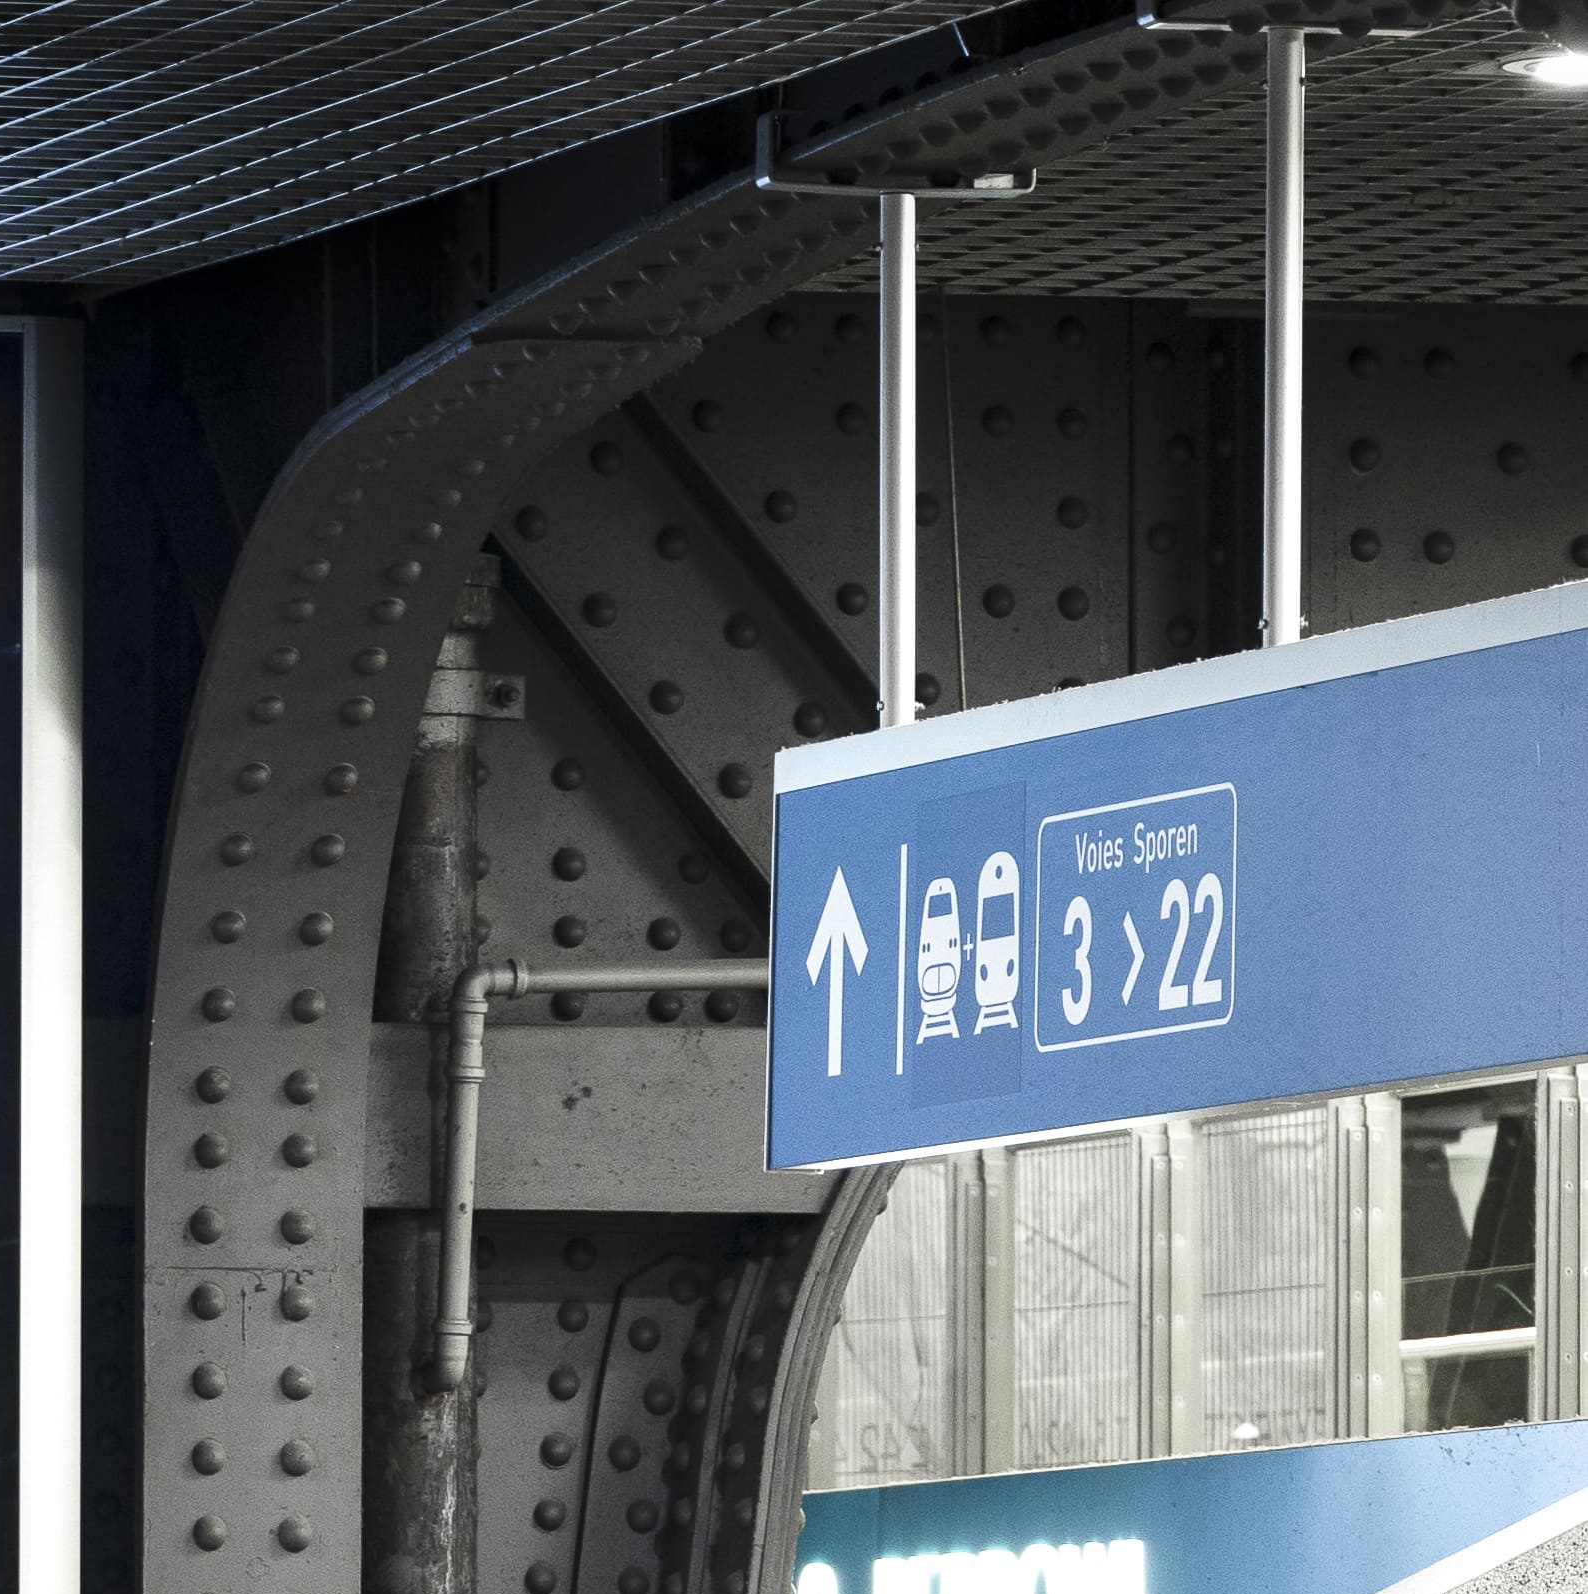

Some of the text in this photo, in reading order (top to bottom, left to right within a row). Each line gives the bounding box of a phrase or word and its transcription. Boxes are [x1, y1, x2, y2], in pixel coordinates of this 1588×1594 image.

[1075, 822, 1198, 874] Voies Sporen
[1061, 873, 1224, 1026] 3 22
